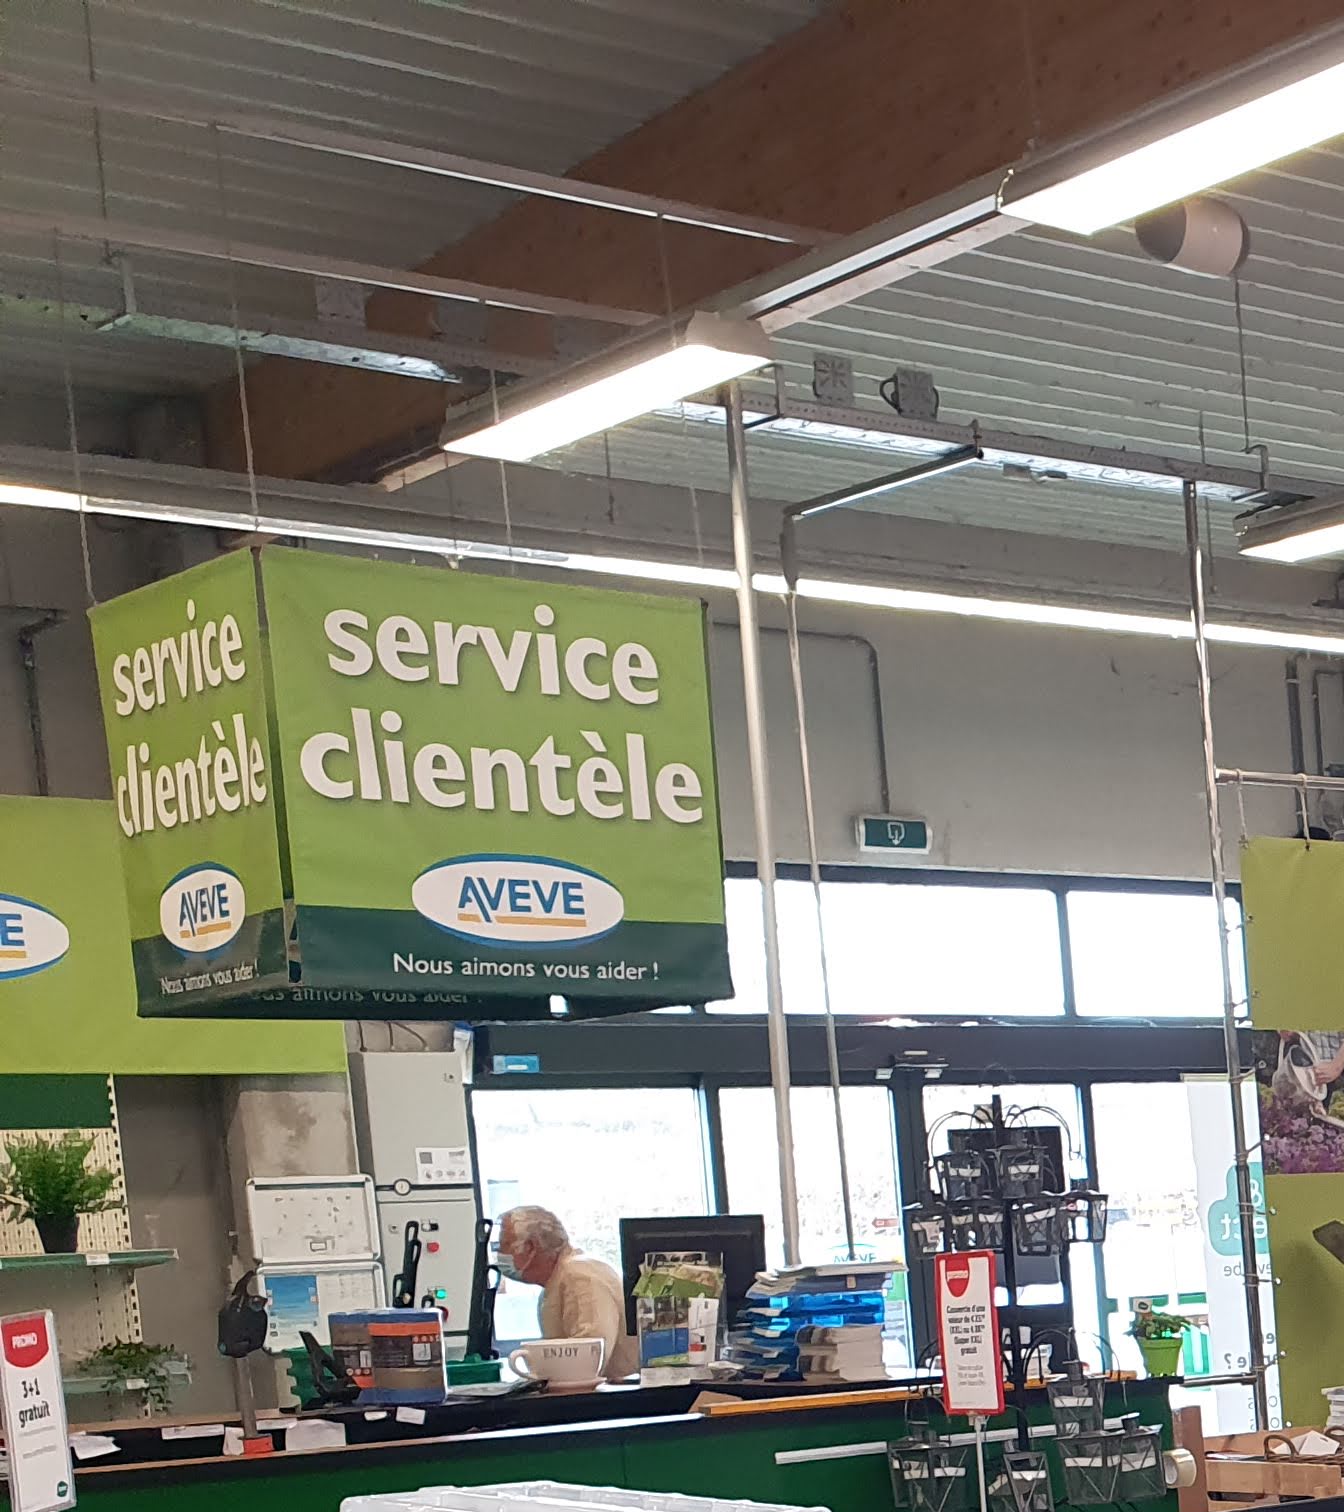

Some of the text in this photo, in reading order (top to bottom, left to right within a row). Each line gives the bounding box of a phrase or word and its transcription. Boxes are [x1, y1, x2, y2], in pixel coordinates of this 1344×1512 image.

[112, 598, 246, 717] service
[323, 605, 660, 705] service
[117, 712, 268, 838] clientèle
[300, 707, 703, 824] clientèle
[179, 882, 230, 931] AVEVE
[457, 874, 586, 924] AVEVE
[213, 967, 234, 985] vous
[393, 953, 660, 981] Nous aimons vous aider !
[543, 1347, 579, 1359] ENJOY
[21, 1377, 41, 1399] 3+1
[18, 1400, 51, 1429] gratuit
